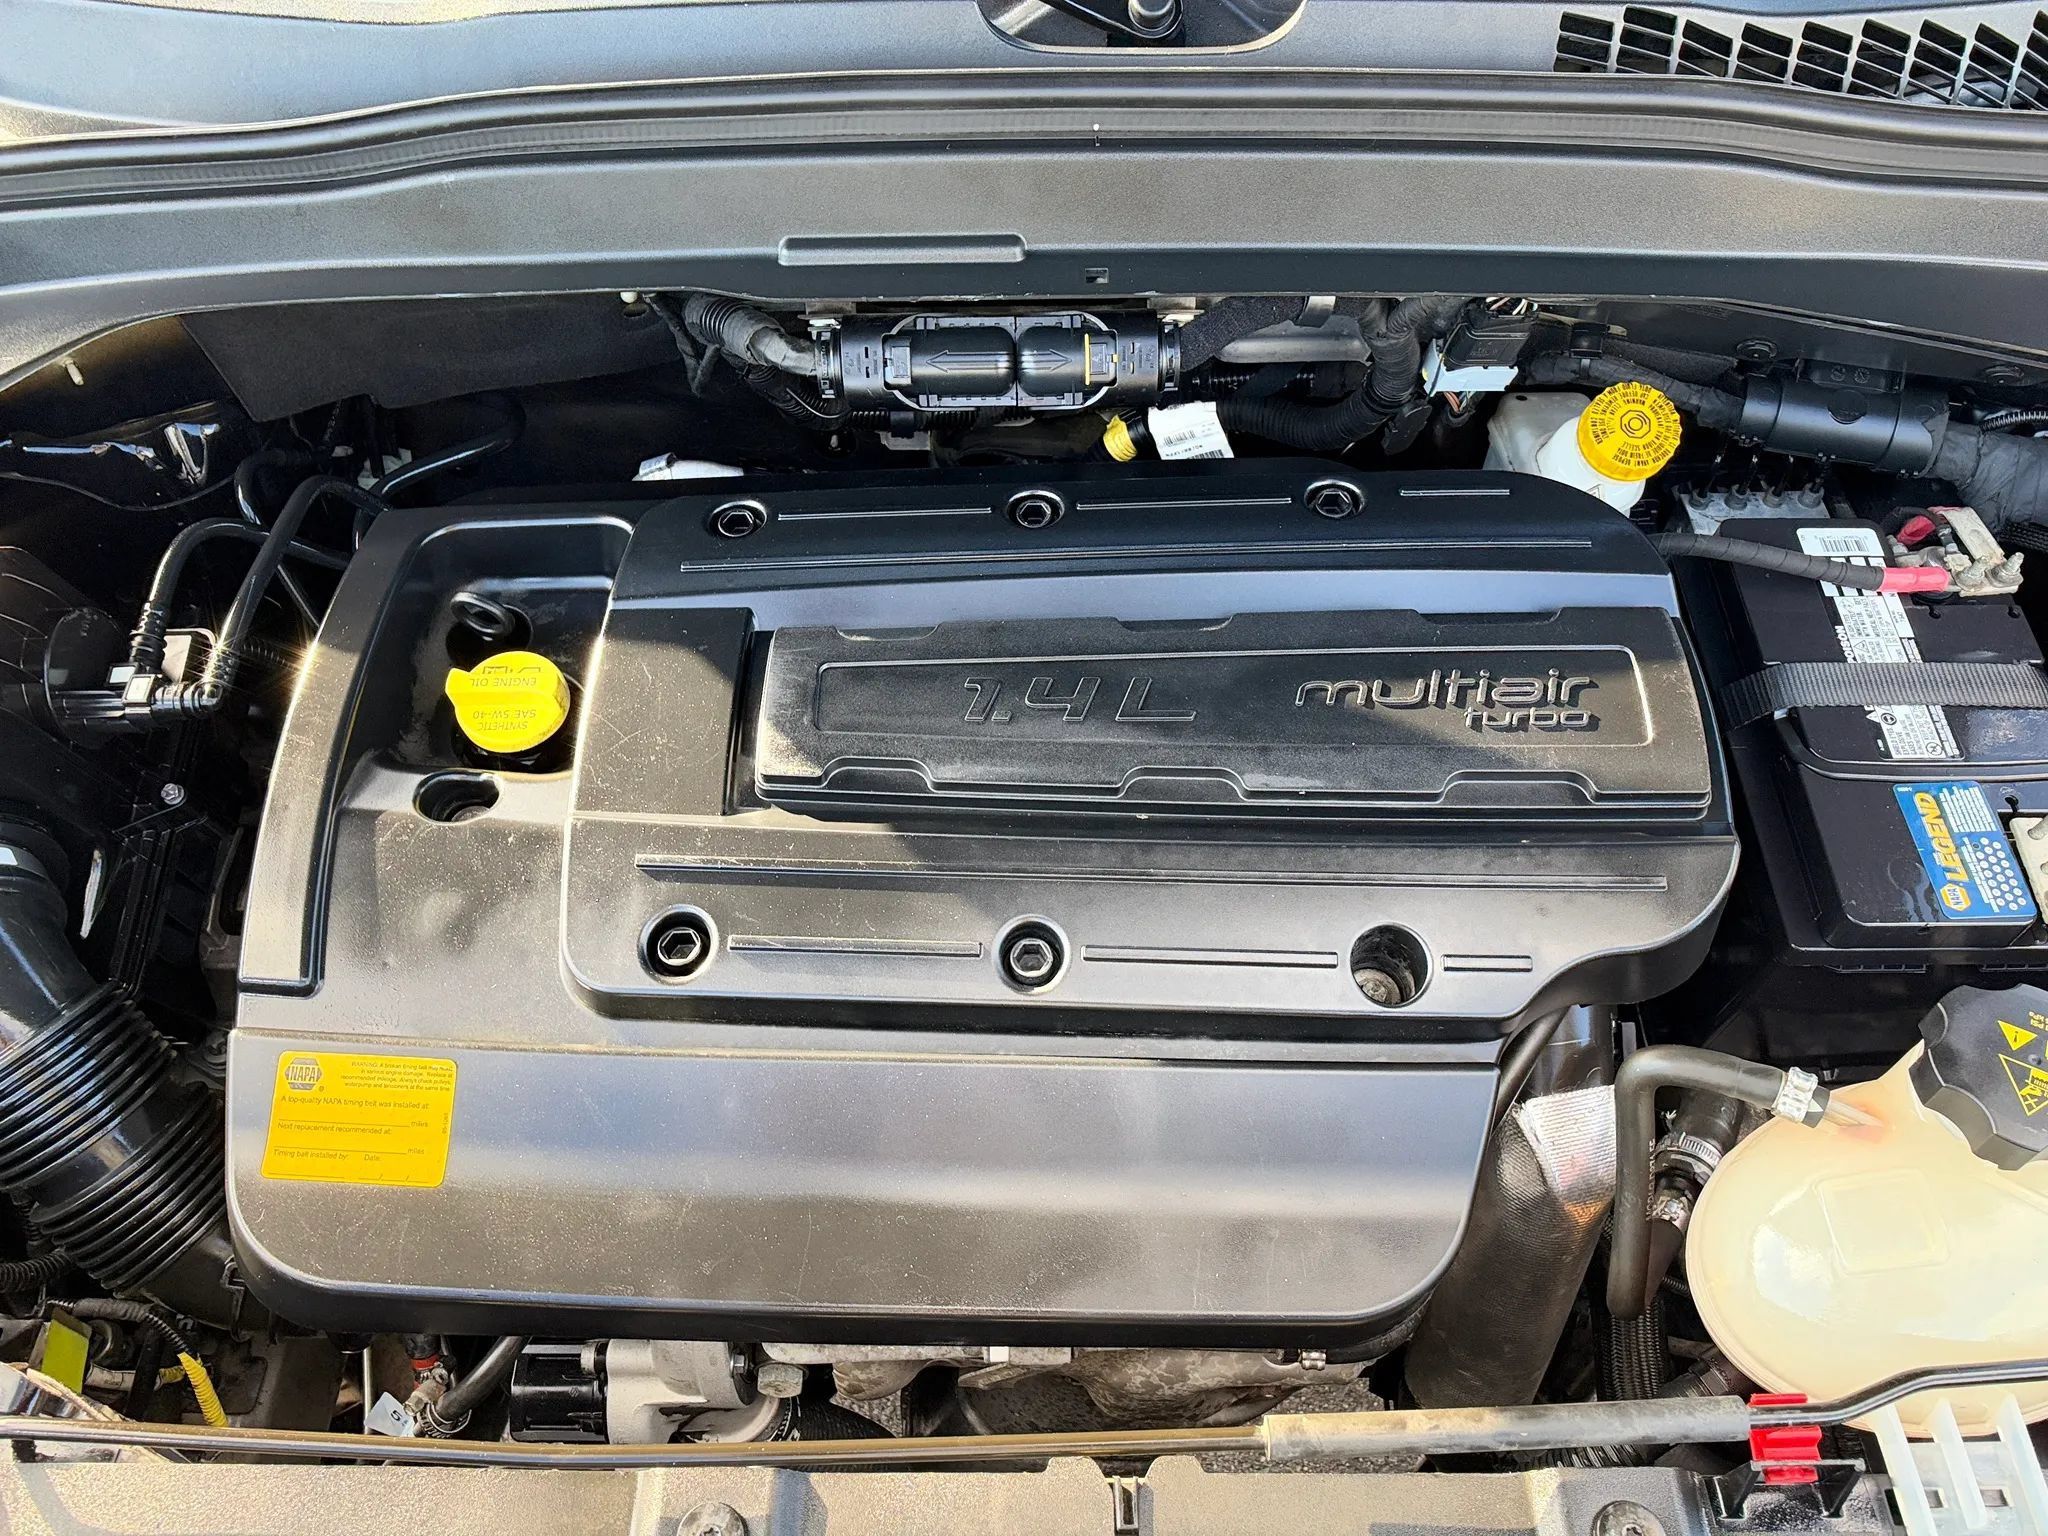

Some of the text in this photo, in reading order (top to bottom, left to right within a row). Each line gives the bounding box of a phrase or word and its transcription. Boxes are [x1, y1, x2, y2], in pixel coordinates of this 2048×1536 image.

[470, 677, 537, 687] ENGINE OIL
[1295, 668, 1590, 706] multiair
[472, 709, 537, 719] SAE 5W-40
[1464, 706, 1592, 727] turbo
[479, 721, 528, 731] SYNTHETIC
[1914, 792, 1969, 882] LEGEND
[1947, 887, 1964, 906] NAPA
[289, 1067, 317, 1082] NAPA
[289, 1096, 321, 1105] top-quality
[323, 1097, 342, 1105] NAPA
[343, 1098, 364, 1107] timing
[365, 1099, 377, 1107] belt
[392, 1101, 420, 1110] installed
[277, 1122, 293, 1130] Next
[294, 1124, 334, 1132] replacement
[335, 1125, 382, 1134] recommended
[273, 1149, 295, 1158] Timing
[296, 1150, 309, 1158] belt
[309, 1151, 337, 1160] installed
[407, 1147, 425, 1155] miles
